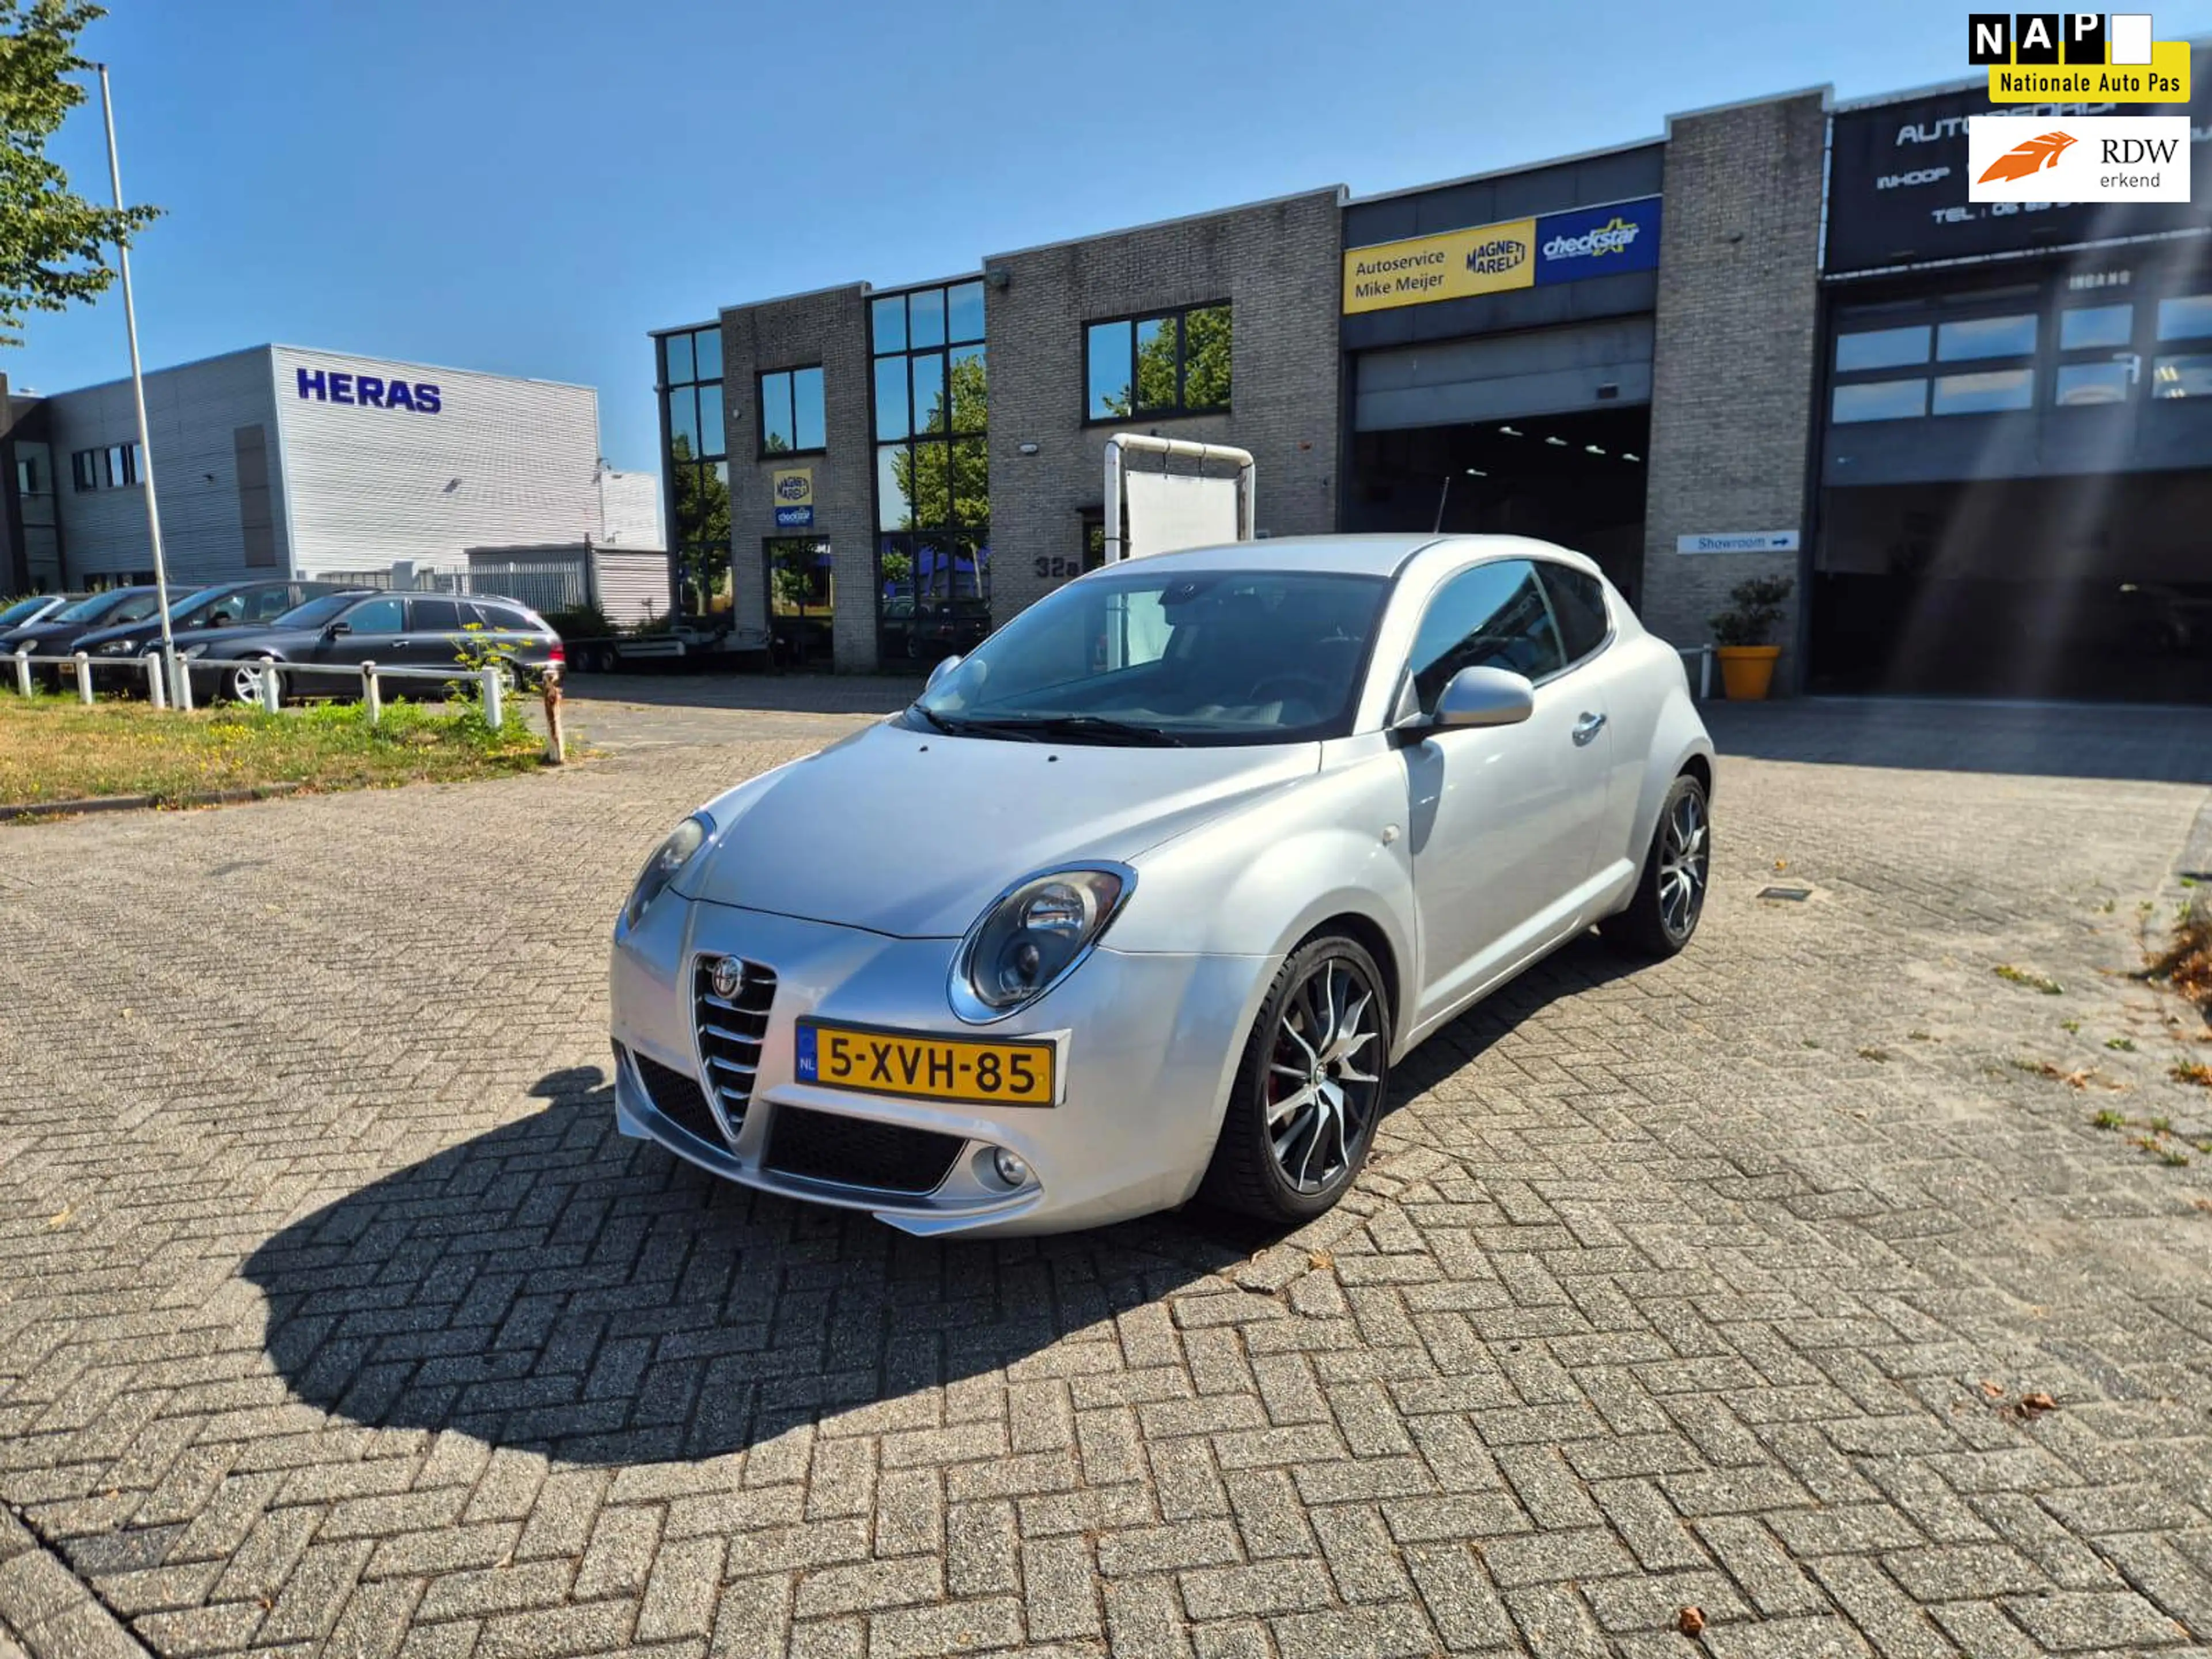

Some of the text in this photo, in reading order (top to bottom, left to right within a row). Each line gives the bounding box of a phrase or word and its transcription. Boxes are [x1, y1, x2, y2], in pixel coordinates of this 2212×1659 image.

[1543, 227, 1639, 256] checkstar
[1356, 251, 1445, 276] Autoservice
[1356, 273, 1444, 298] Mike Meijer
[297, 368, 441, 414] HERAS
[1698, 537, 1766, 551] Showroom
[800, 1060, 816, 1071] NL
[830, 1037, 1035, 1094] 5-XVH-85
